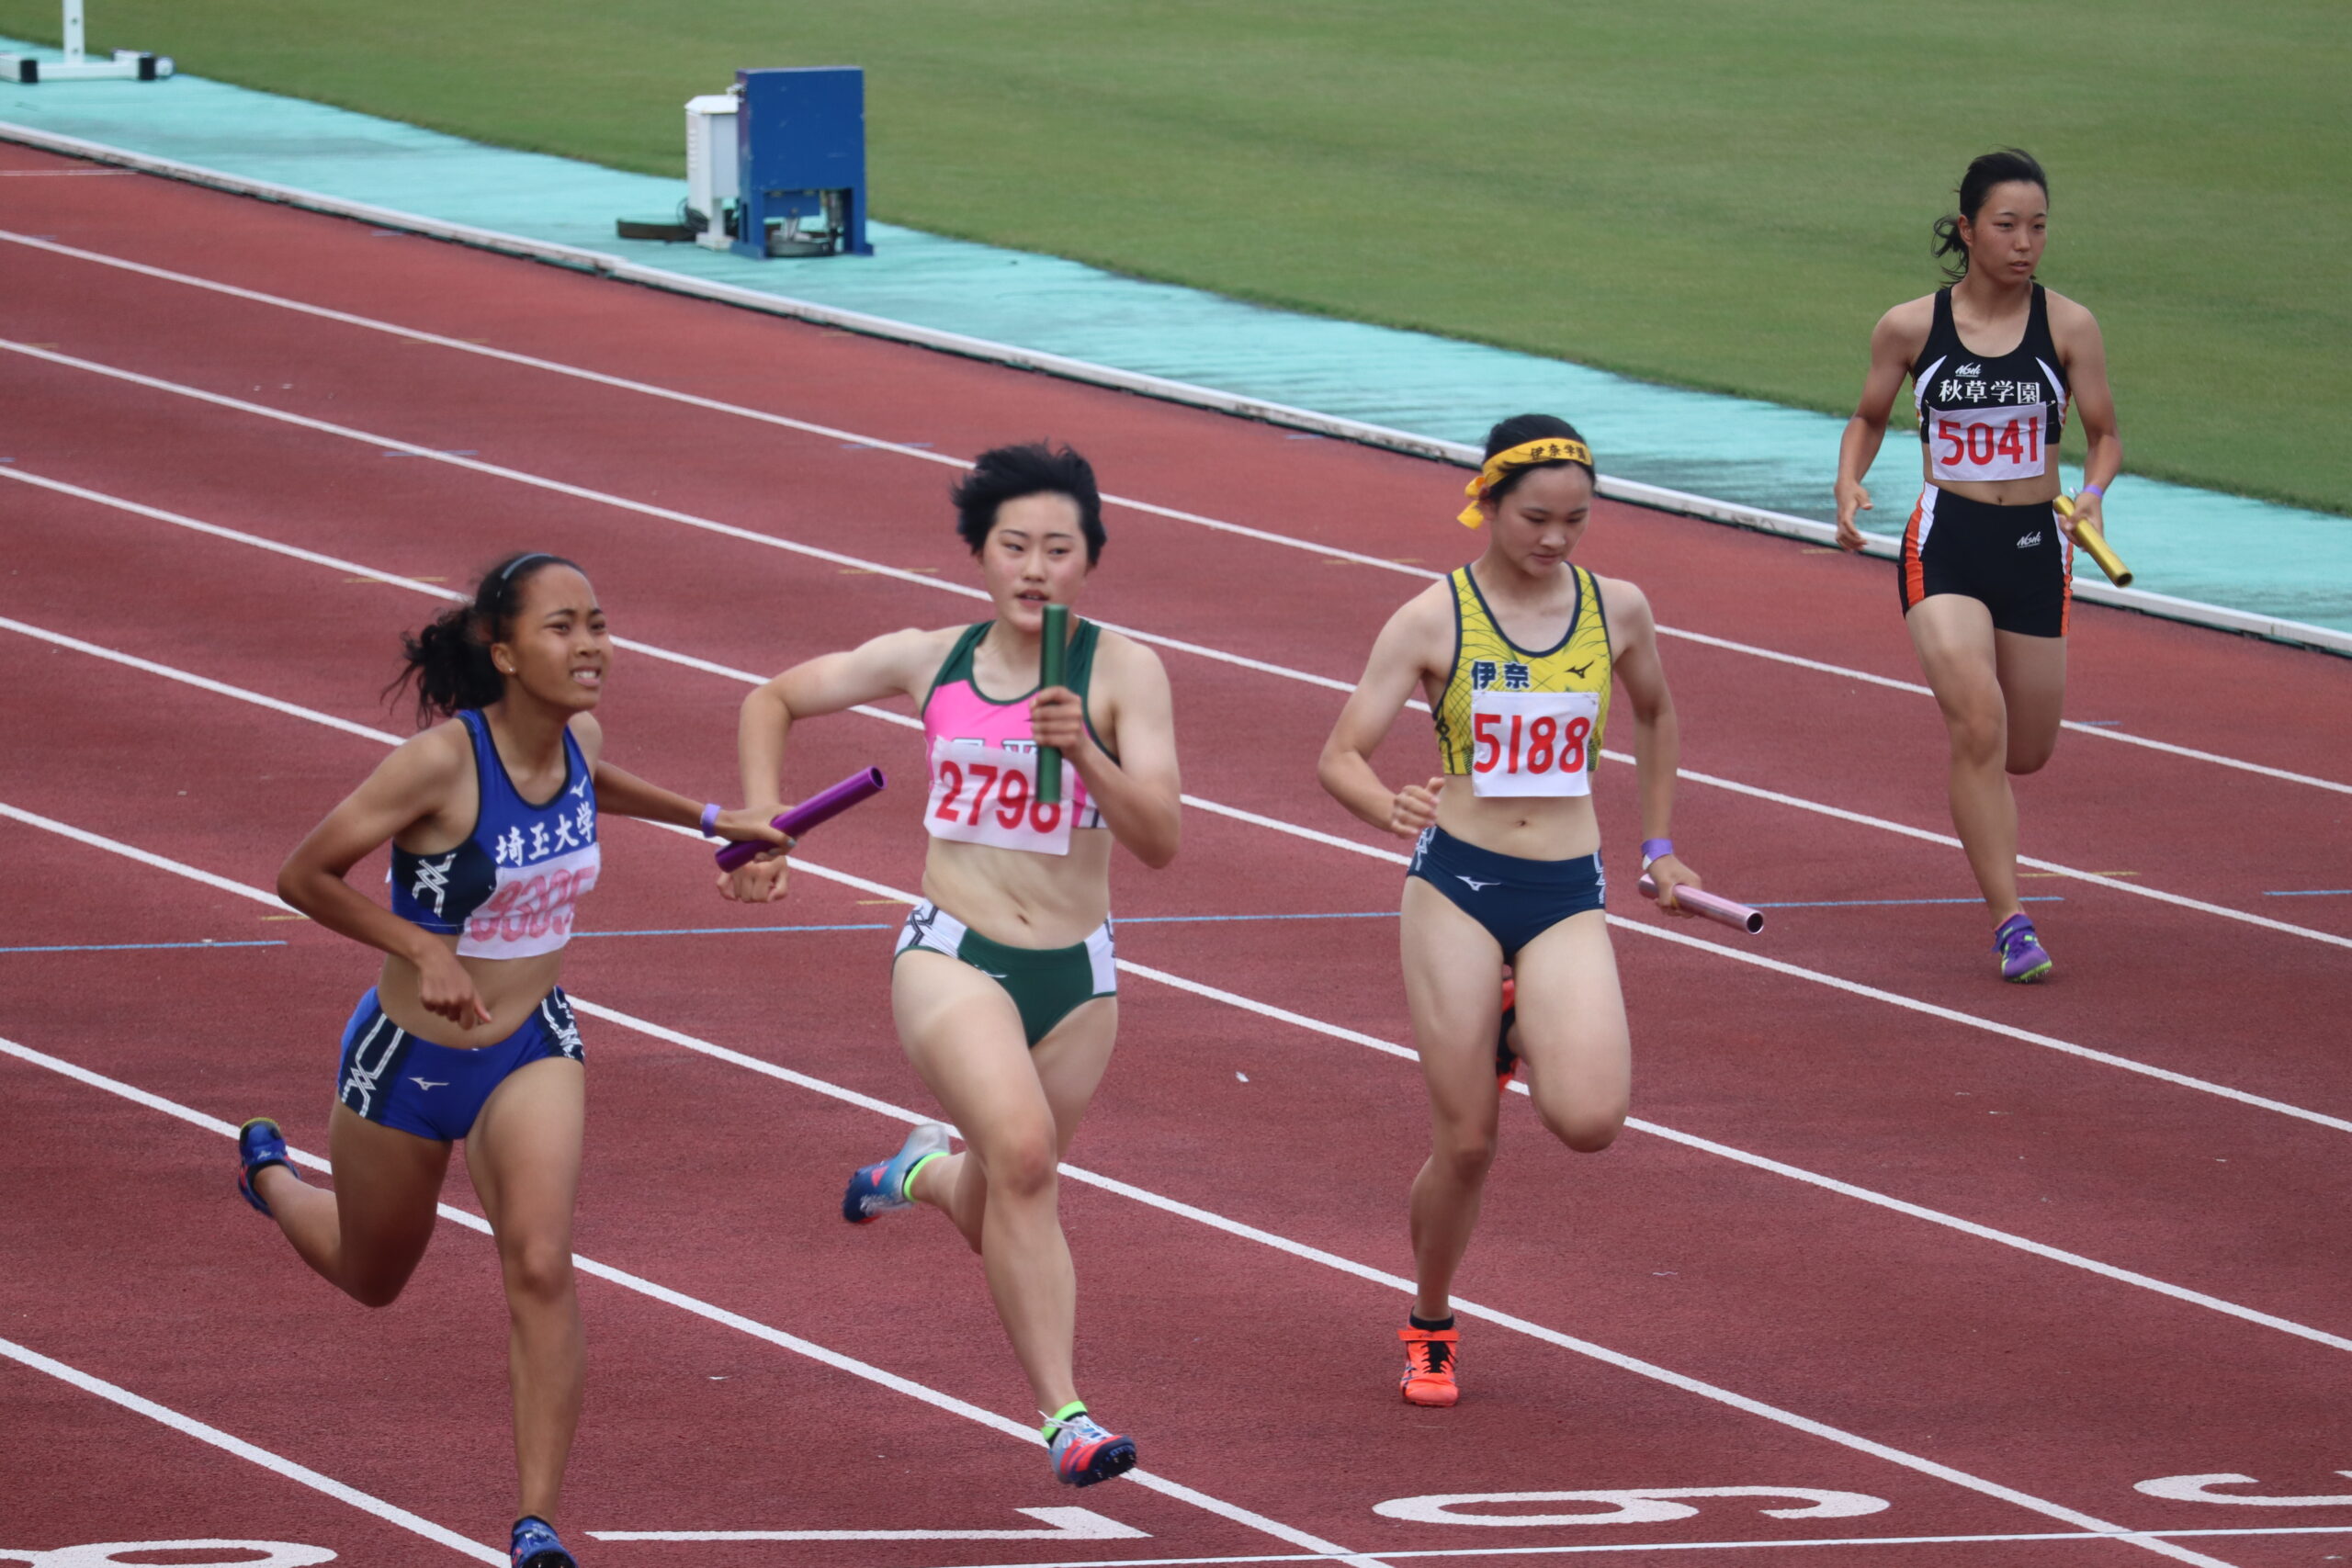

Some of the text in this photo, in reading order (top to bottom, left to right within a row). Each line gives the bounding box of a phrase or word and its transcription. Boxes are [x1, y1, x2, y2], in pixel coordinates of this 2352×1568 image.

[1938, 378, 2041, 405] 秋草学園
[1938, 416, 2038, 467] 5041
[1471, 660, 1531, 690] 伊奈
[1473, 713, 1590, 774] 5188
[494, 800, 595, 867] 埼玉大学
